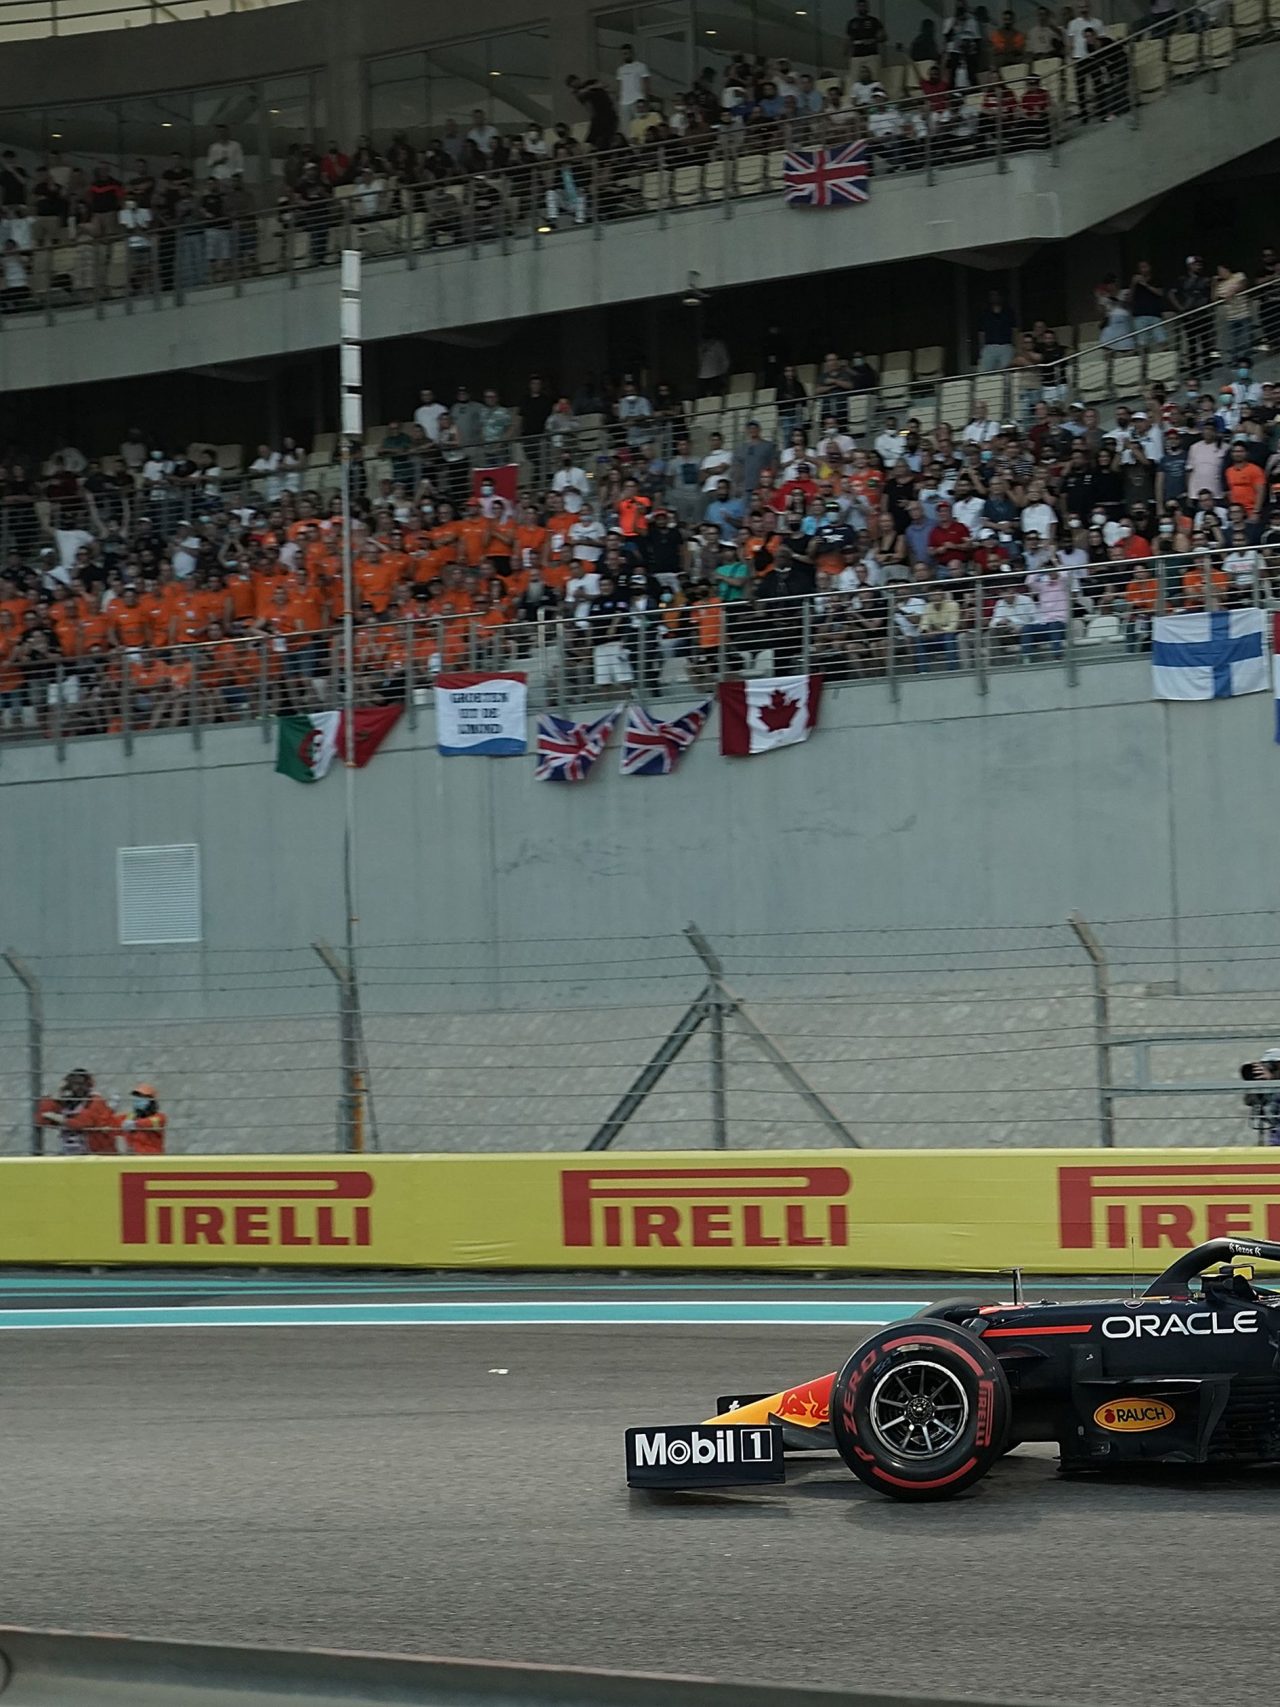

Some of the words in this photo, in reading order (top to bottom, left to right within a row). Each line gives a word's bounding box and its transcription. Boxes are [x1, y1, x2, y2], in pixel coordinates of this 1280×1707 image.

[121, 1171, 375, 1246] PIRELLI
[560, 1167, 852, 1248] PIRELLI
[1101, 1310, 1258, 1339] ORACLE
[843, 1349, 877, 1436] ZERO
[975, 1380, 994, 1447] PIRELLI
[1116, 1407, 1167, 1423] RAUCH
[635, 1430, 735, 1467] Mobil
